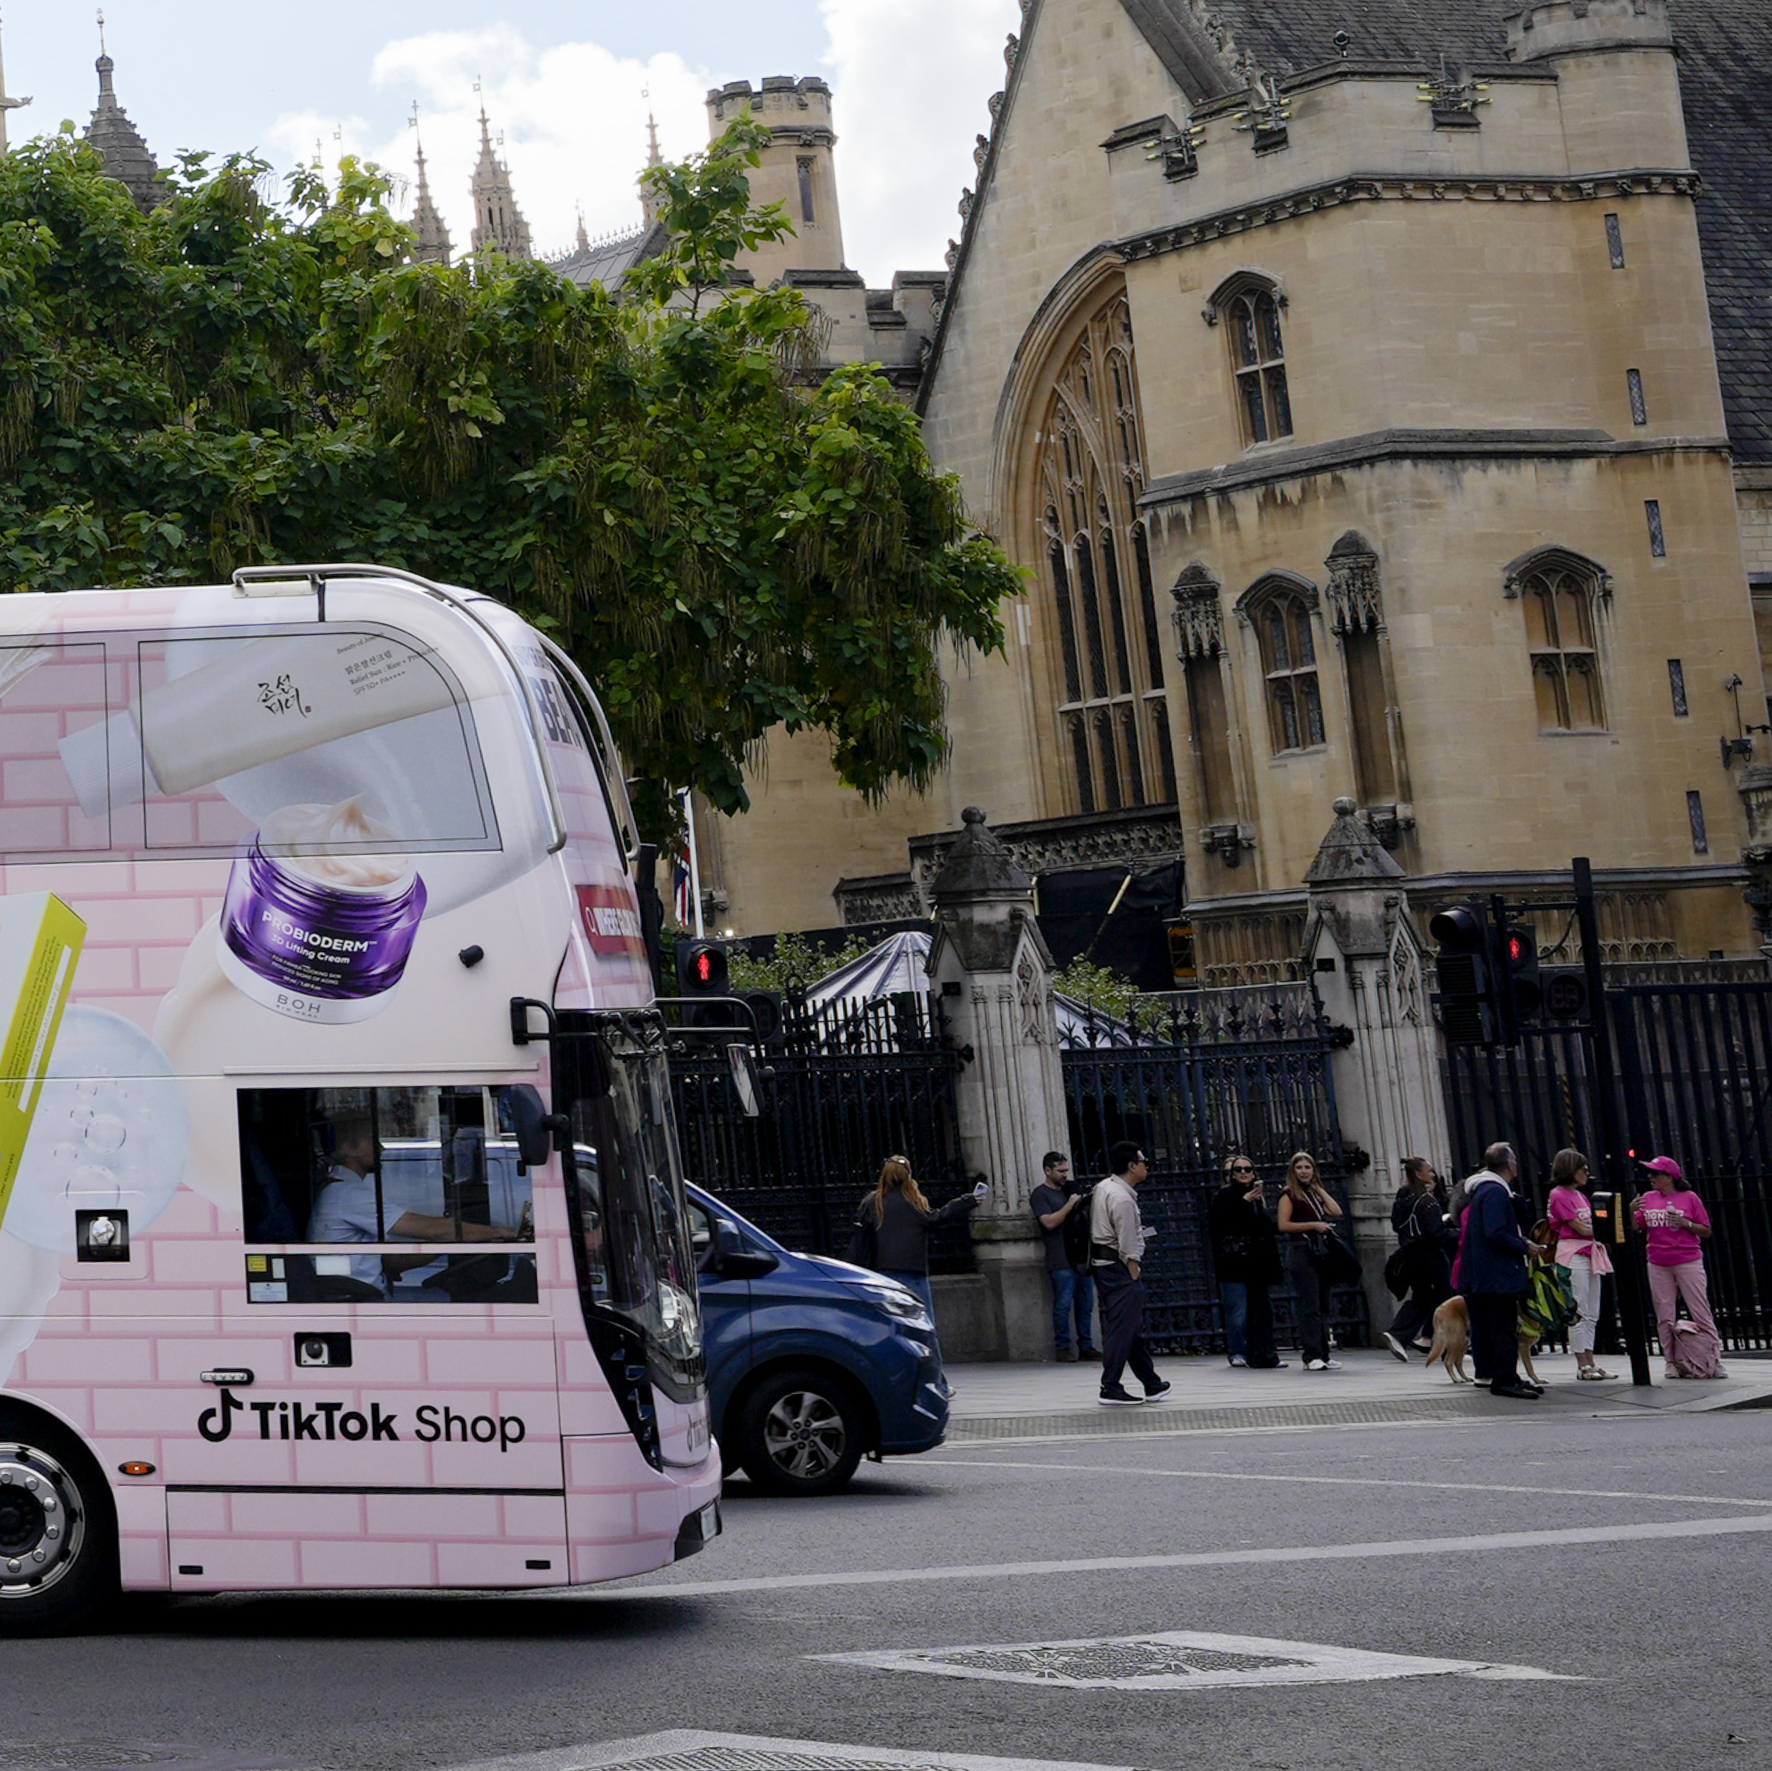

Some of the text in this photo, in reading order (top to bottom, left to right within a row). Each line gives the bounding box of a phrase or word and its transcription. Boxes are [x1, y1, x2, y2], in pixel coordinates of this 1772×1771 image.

[270, 932, 351, 965] 3D Lifting Cream
[276, 994, 322, 1014] BOH
[249, 1401, 526, 1454] TikTok Shop
